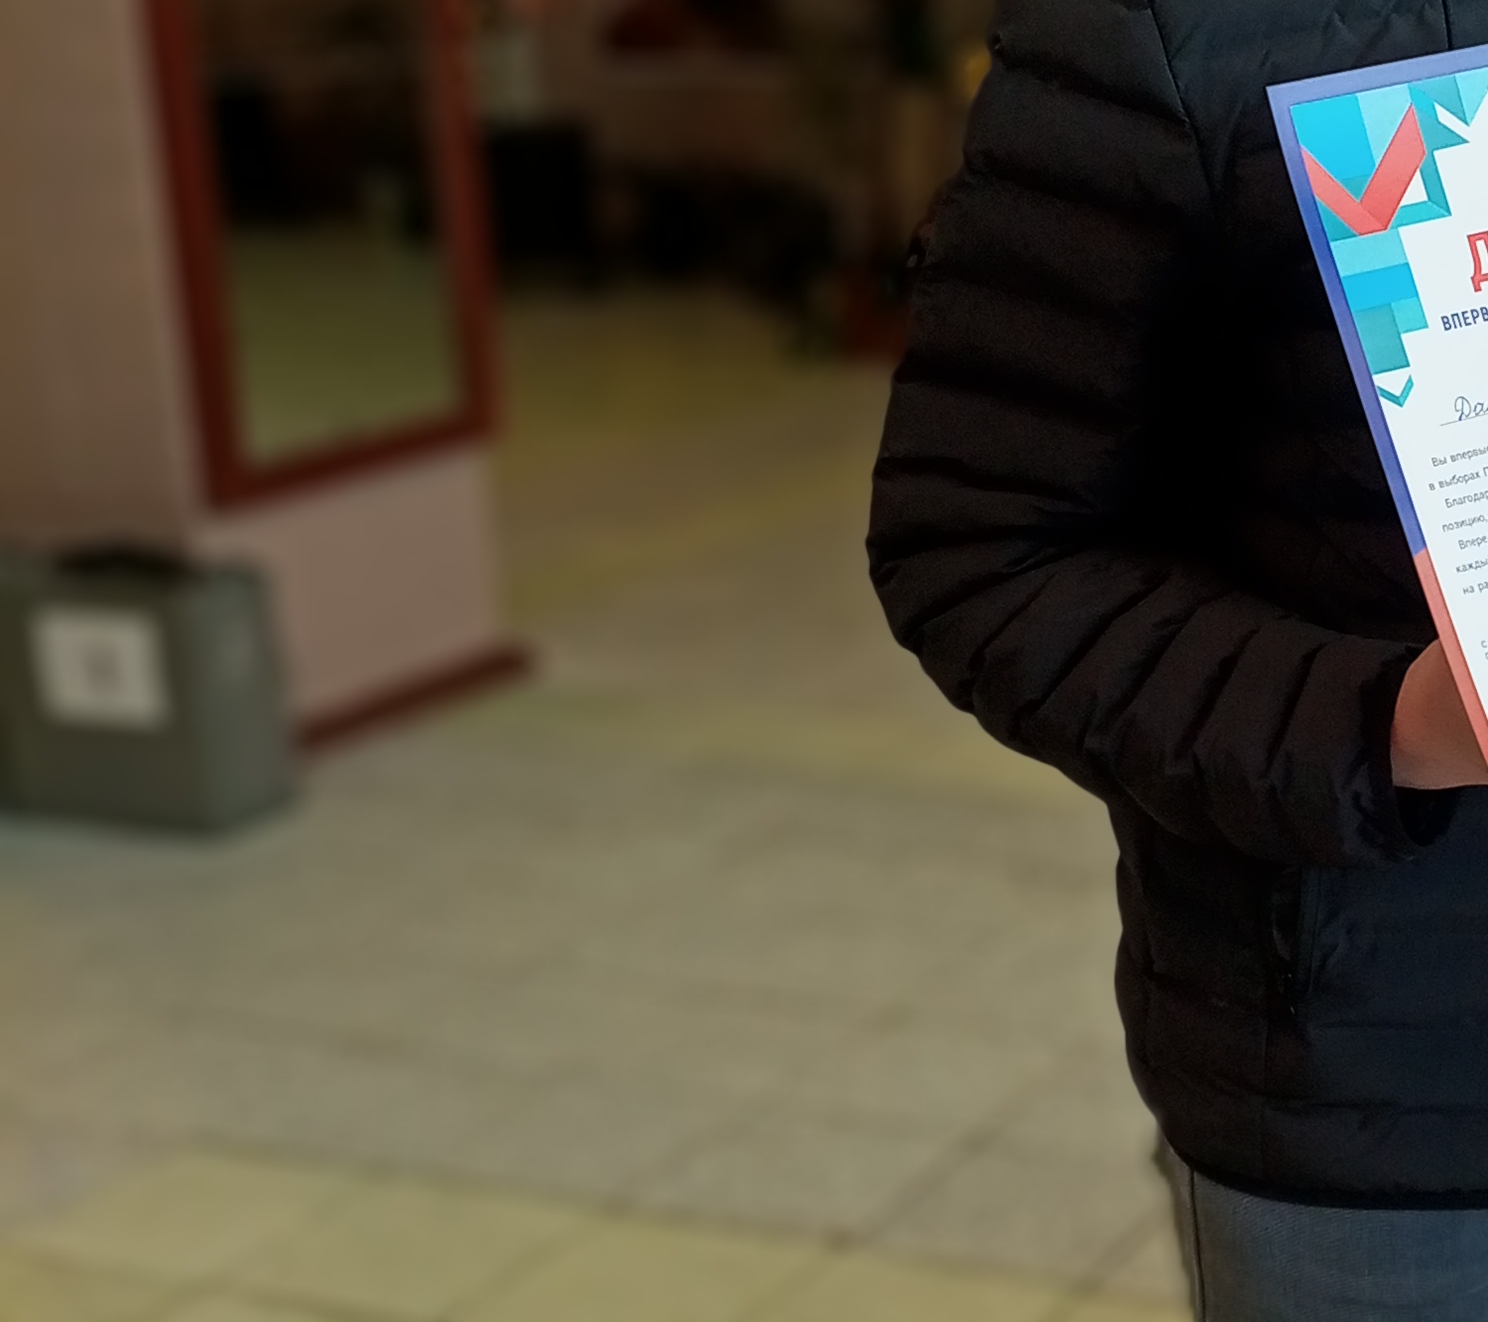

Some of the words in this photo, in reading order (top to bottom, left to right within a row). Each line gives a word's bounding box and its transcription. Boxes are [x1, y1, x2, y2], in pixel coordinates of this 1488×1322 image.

[1430, 456, 1448, 467] Вы
[1428, 482, 1436, 491] в
[1437, 471, 1481, 489] выборах
[1441, 514, 1488, 532] позицию,
[1462, 585, 1475, 595] на
